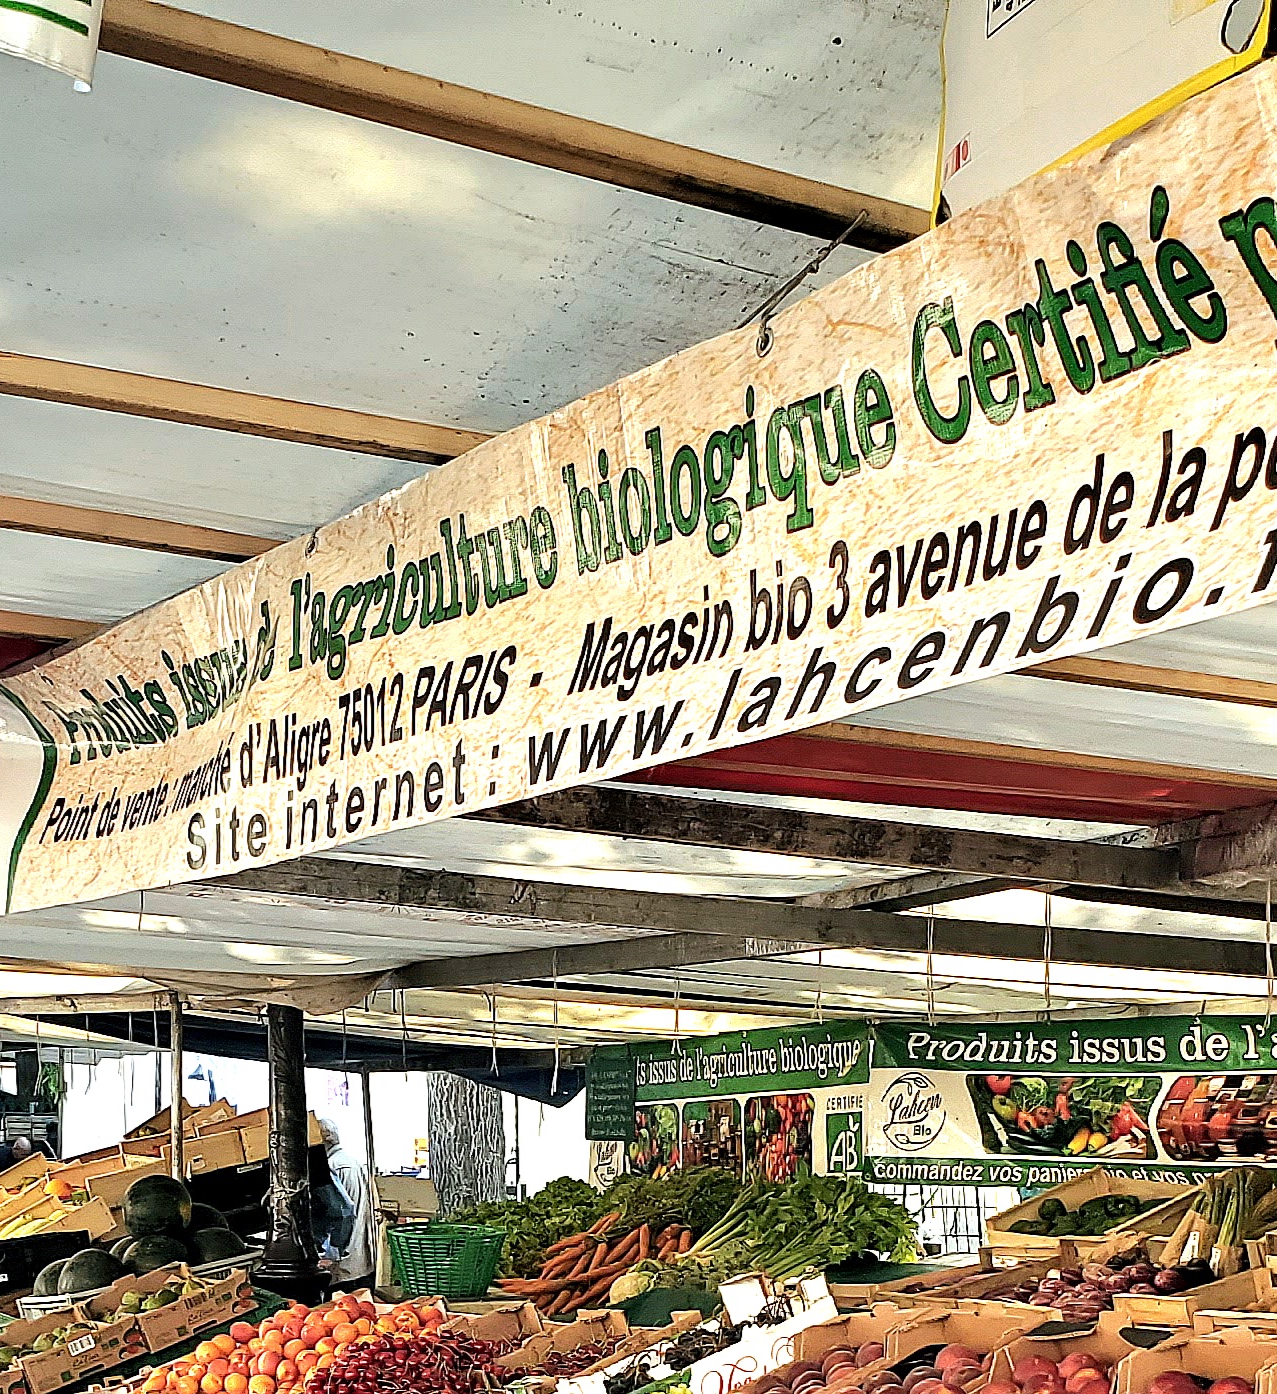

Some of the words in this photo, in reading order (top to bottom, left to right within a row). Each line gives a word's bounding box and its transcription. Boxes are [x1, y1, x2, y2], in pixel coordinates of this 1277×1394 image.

[288, 506, 560, 680] l'agriculture
[571, 368, 897, 577] biologique
[911, 185, 1228, 445] Certifié
[38, 793, 101, 844] Point
[95, 787, 120, 838] de
[120, 778, 169, 834] vente
[240, 712, 332, 791] d'Aligre
[338, 672, 404, 762] 75012
[411, 645, 517, 734] PARIS
[567, 586, 734, 701] Magasin
[745, 570, 812, 648] bio
[827, 540, 849, 629] 3
[865, 499, 1048, 614] avenue
[1064, 454, 1135, 552] de
[1146, 429, 1208, 528] la
[186, 805, 267, 870] Site
[284, 740, 466, 848] internet
[648, 1055, 677, 1085] issus
[680, 1051, 693, 1082] de
[696, 1040, 776, 1088] l'agriculture
[779, 1033, 861, 1081] biologique
[907, 1030, 1058, 1065] Produits
[1068, 1029, 1166, 1063] issus
[1179, 1016, 1229, 1061] de
[830, 1128, 858, 1172] AB
[873, 1159, 984, 1182] commandez
[988, 1166, 1023, 1183] vos
[1026, 1163, 1093, 1189] panier
